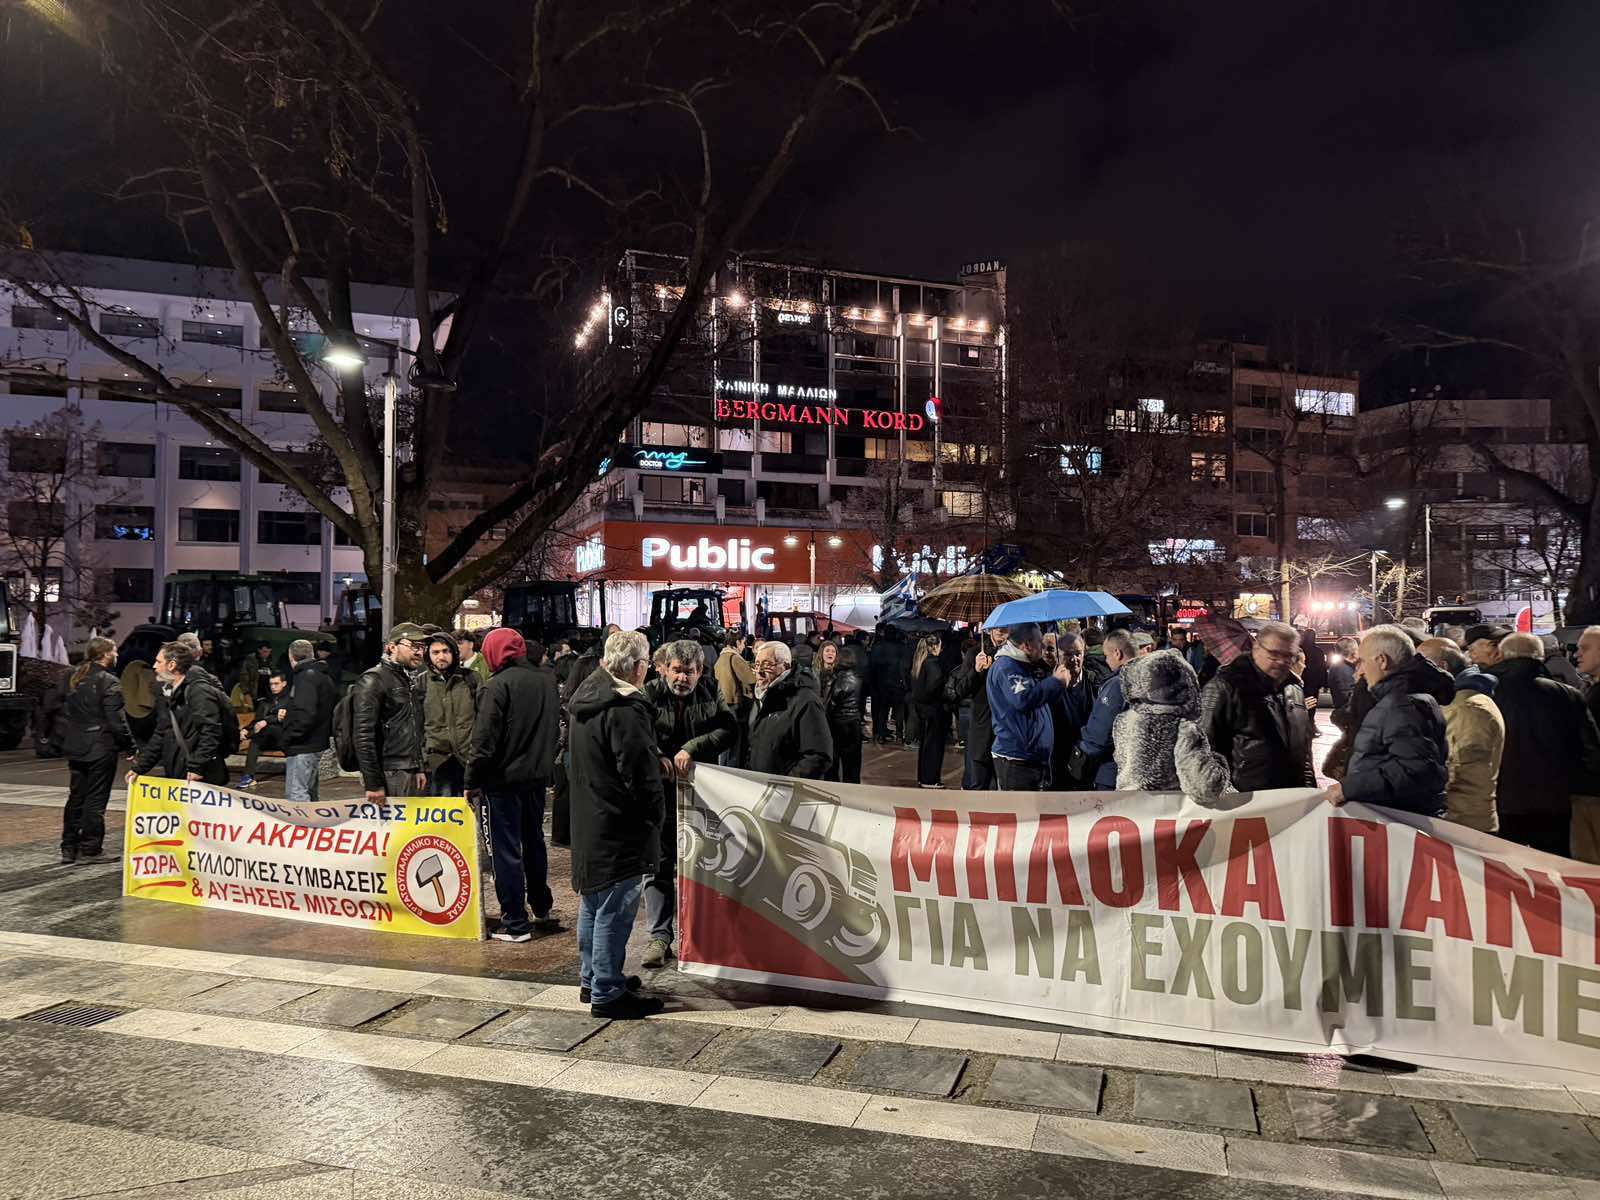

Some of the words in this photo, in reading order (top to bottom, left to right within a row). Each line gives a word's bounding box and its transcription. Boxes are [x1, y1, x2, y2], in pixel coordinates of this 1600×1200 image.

[716, 399, 849, 425] BERGMANN
[862, 409, 923, 431] KORD
[641, 537, 775, 570] Public
[139, 783, 161, 799] Τα
[167, 786, 232, 808] ΚΕΡΔΗ
[240, 796, 291, 817] τους
[316, 807, 340, 818] οι
[344, 803, 407, 821] ΖΩΕΣ
[415, 806, 464, 826] μας
[135, 815, 180, 835] STOP
[188, 820, 244, 842] στην
[247, 821, 390, 857] ΑΚΡΙΒΕΙΑ!
[433, 838, 464, 867] ΚΕΝΤΡΟ
[132, 855, 180, 876] ΤΩΡΑ
[188, 850, 279, 882] ΣΥΛΛΟΓΙΚΕΣ
[284, 864, 388, 894] ΣΥΜΒΑΣΕΙΣ
[890, 806, 1285, 921] ΜΠΛΟΚΑ
[191, 877, 203, 897] &
[208, 880, 300, 911] ΑΥΞΗΣΕΙΣ
[304, 893, 393, 922] ΜΙΣΘΩΝ
[446, 882, 470, 920] ΛΑΡΙΣΑΣ
[893, 895, 989, 971] ΓΙΑ
[1011, 906, 1103, 986] ΝΑ
[1130, 911, 1437, 1022] ΕΧΟΥΜΕ
